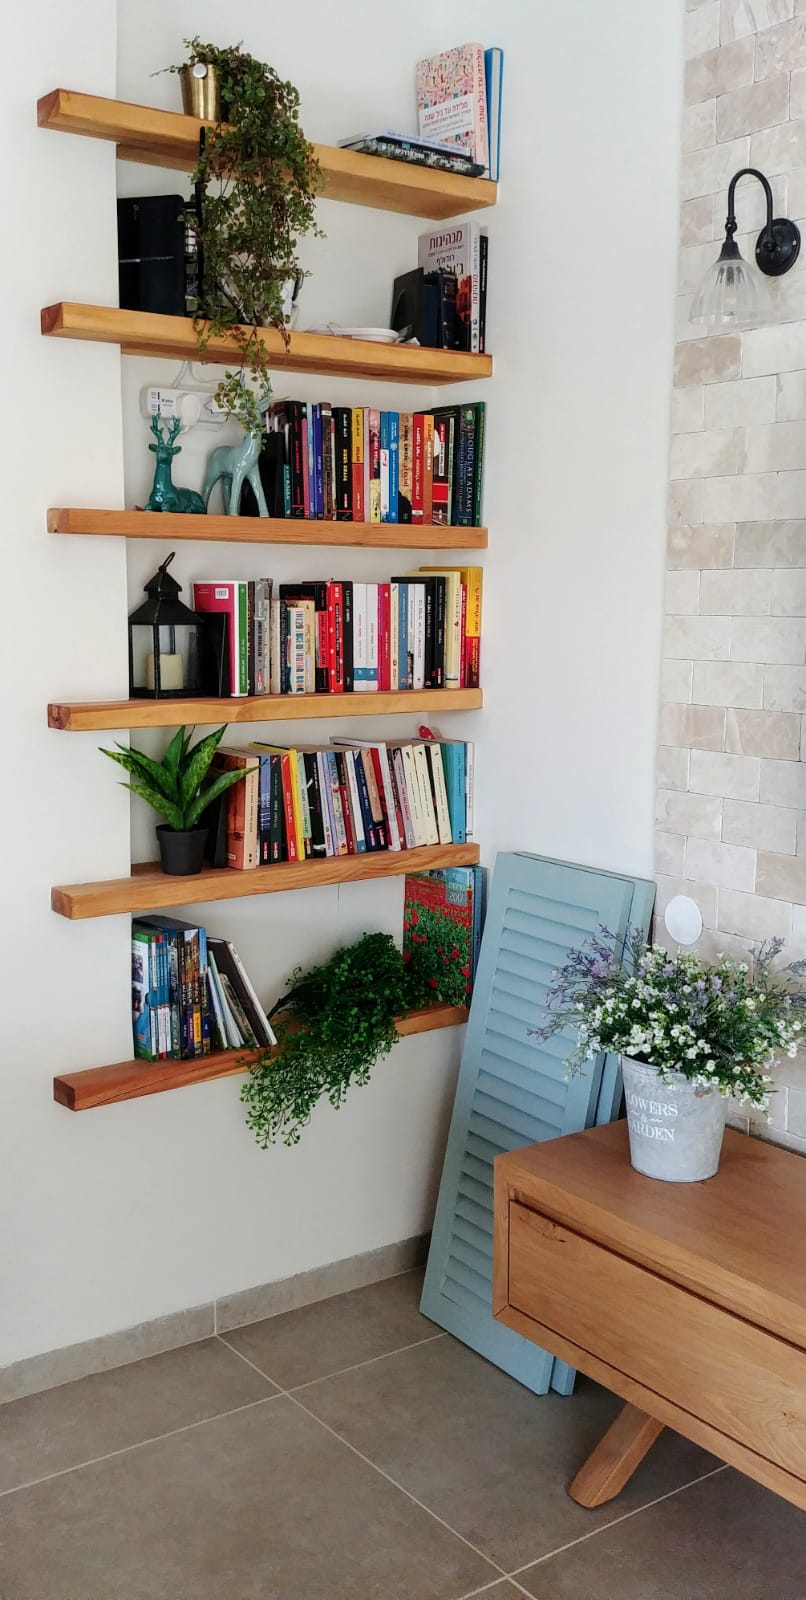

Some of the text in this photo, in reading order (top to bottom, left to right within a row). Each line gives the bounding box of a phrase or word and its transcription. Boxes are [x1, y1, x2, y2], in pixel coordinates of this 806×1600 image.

[429, 230, 463, 250] מנהיגות
[465, 432, 475, 513] DOUGLAS ADAMS
[449, 891, 464, 902] 2017
[628, 1092, 678, 1116] LOWERS
[630, 1119, 675, 1141] ARDEN
